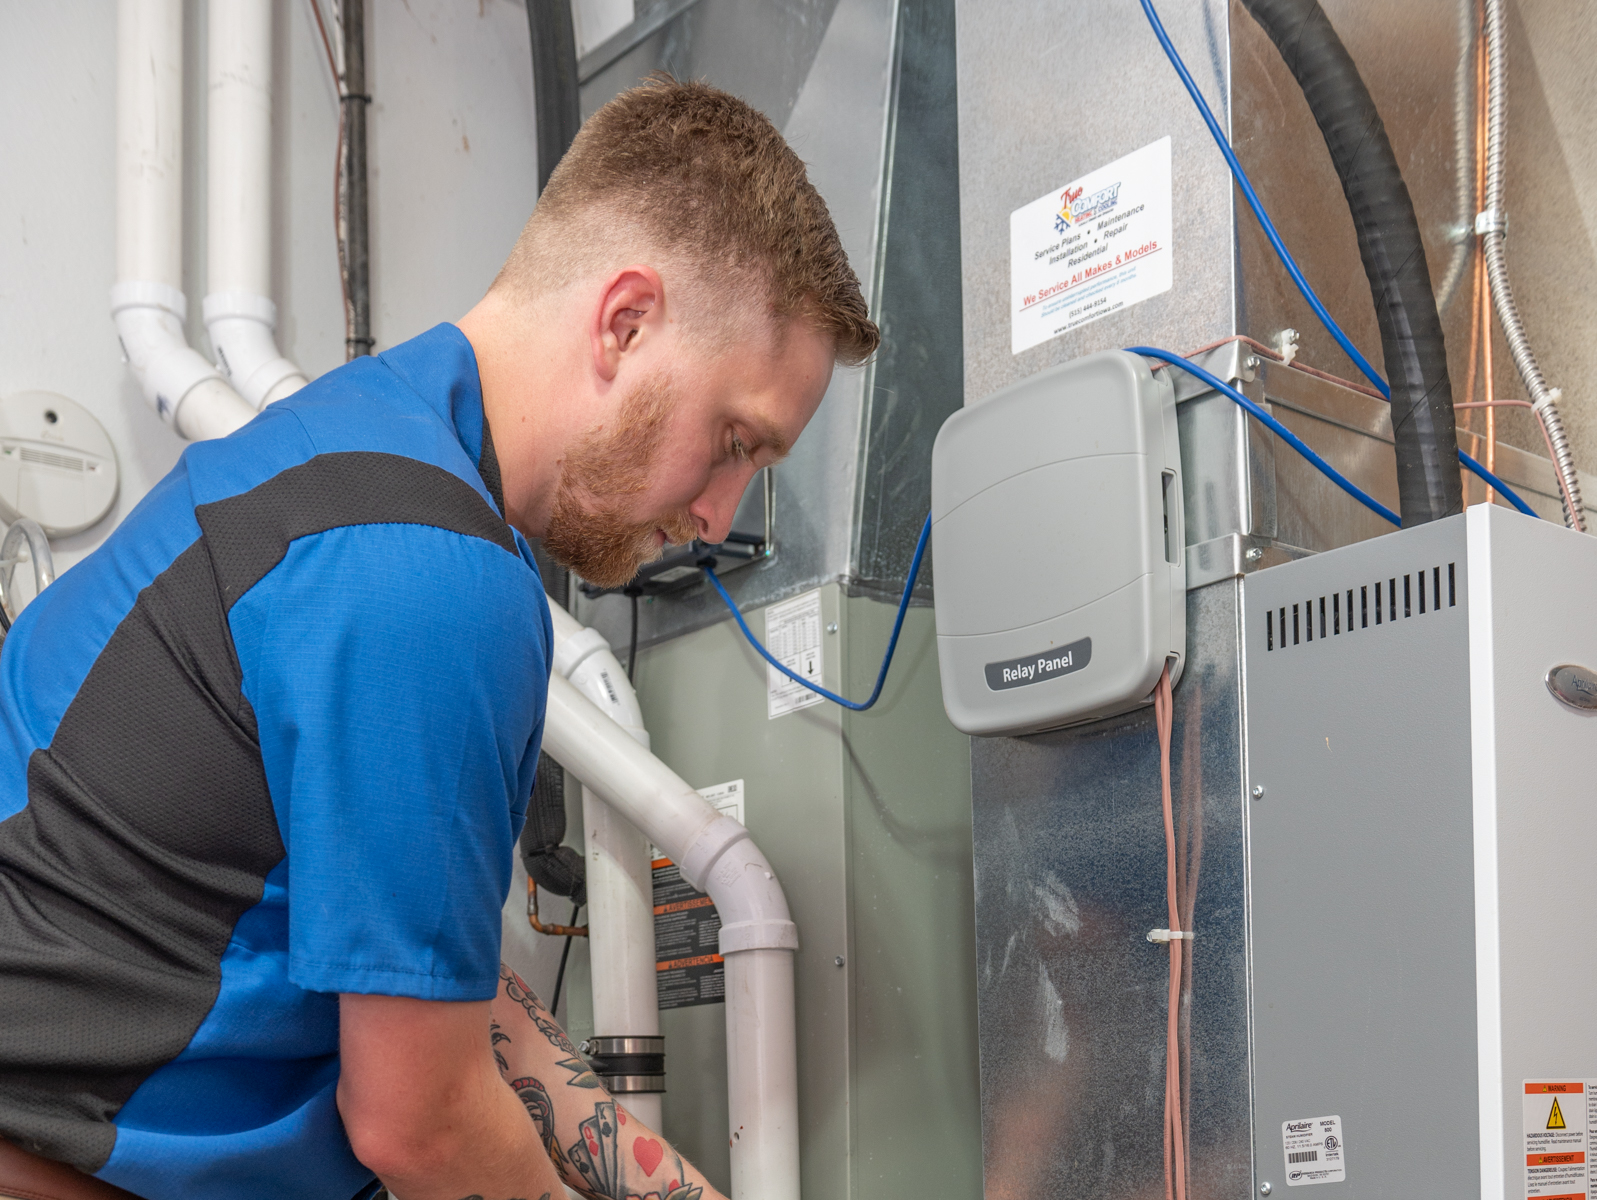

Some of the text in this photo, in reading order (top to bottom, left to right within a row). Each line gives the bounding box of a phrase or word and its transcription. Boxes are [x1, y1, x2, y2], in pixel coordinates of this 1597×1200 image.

[1061, 186, 1083, 209] True
[1071, 181, 1121, 216] COMFORT
[1034, 243, 1060, 261] Service
[1061, 232, 1081, 248] Plans
[1097, 203, 1145, 231] Maintenance
[1049, 222, 1128, 265] Installation Repair
[1067, 243, 1108, 268] Residential
[1023, 240, 1158, 306] We Service All Makes & Models
[1053, 301, 1124, 334] www.truecomfortiowa.com
[1069, 307, 1083, 319] (515)
[1003, 651, 1073, 682] Relay Panel
[669, 897, 714, 911] AVERTISSEMEN
[674, 955, 714, 967] ADVERTENCIA
[1548, 1084, 1566, 1092] WARNING
[600, 1106, 607, 1120] K
[584, 1126, 594, 1140] Q
[1286, 1121, 1313, 1132] Aprilaire
[575, 1149, 581, 1162] J
[1544, 1154, 1574, 1163] AVERTISSEMENT
